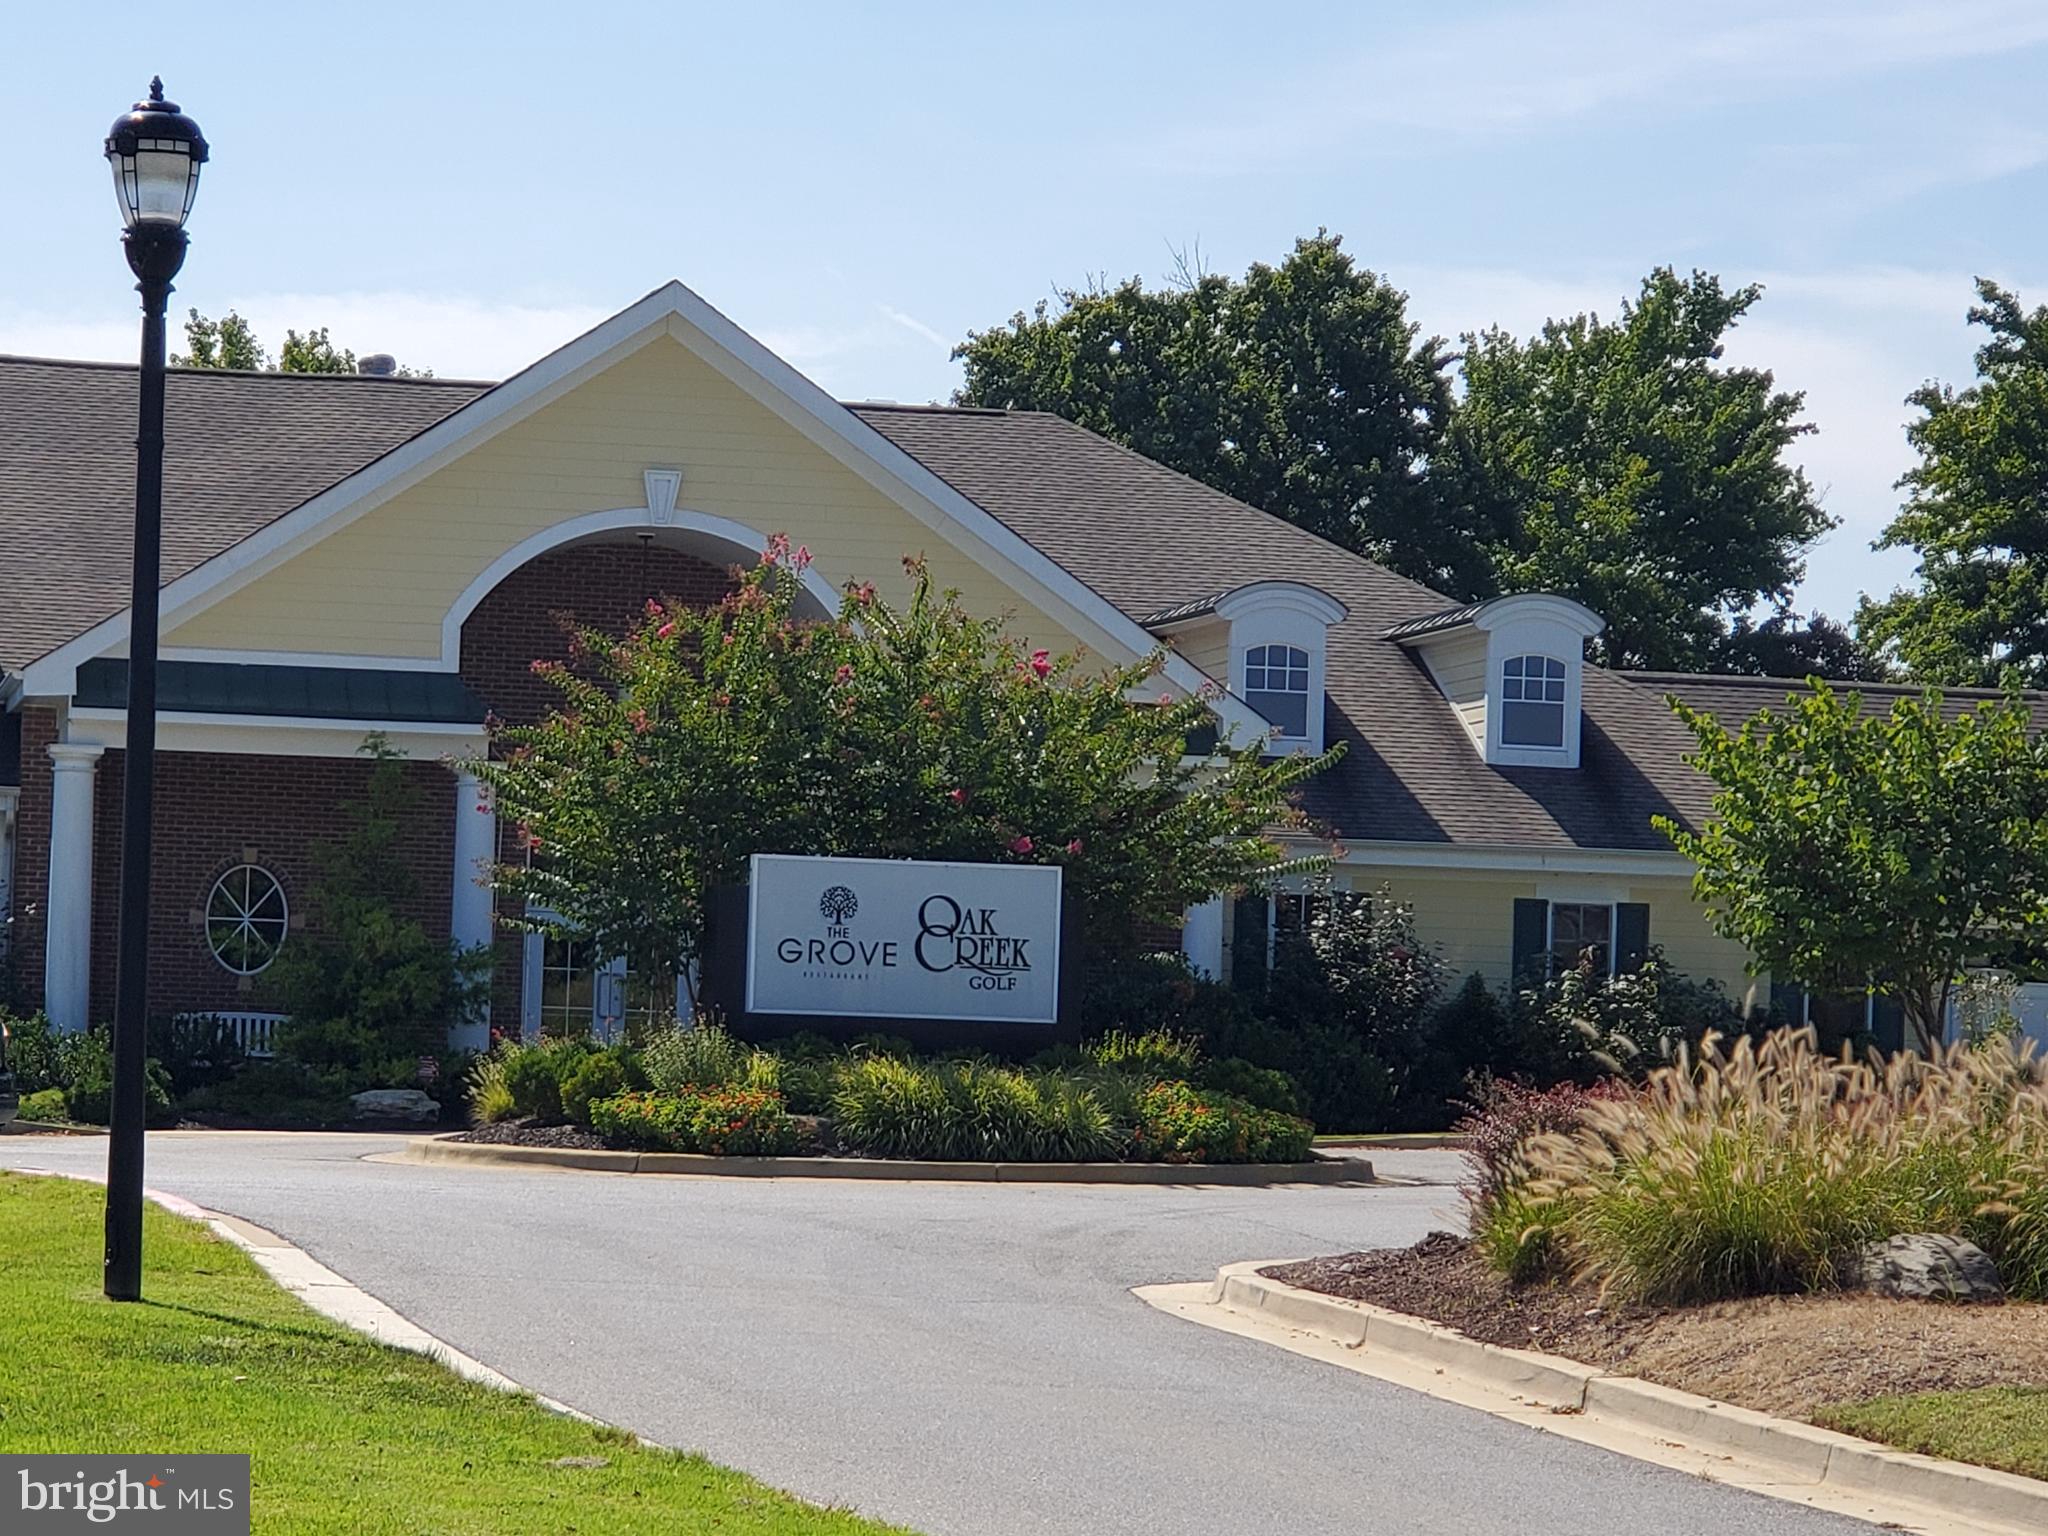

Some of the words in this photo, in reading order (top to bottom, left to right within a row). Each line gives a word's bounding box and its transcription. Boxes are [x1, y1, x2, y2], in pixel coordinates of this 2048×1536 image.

[918, 894, 998, 937] OAK
[827, 926, 850, 938] THE
[777, 937, 898, 967] GROVE
[914, 924, 1032, 976] CREEK
[969, 976, 1017, 991] GOLF
